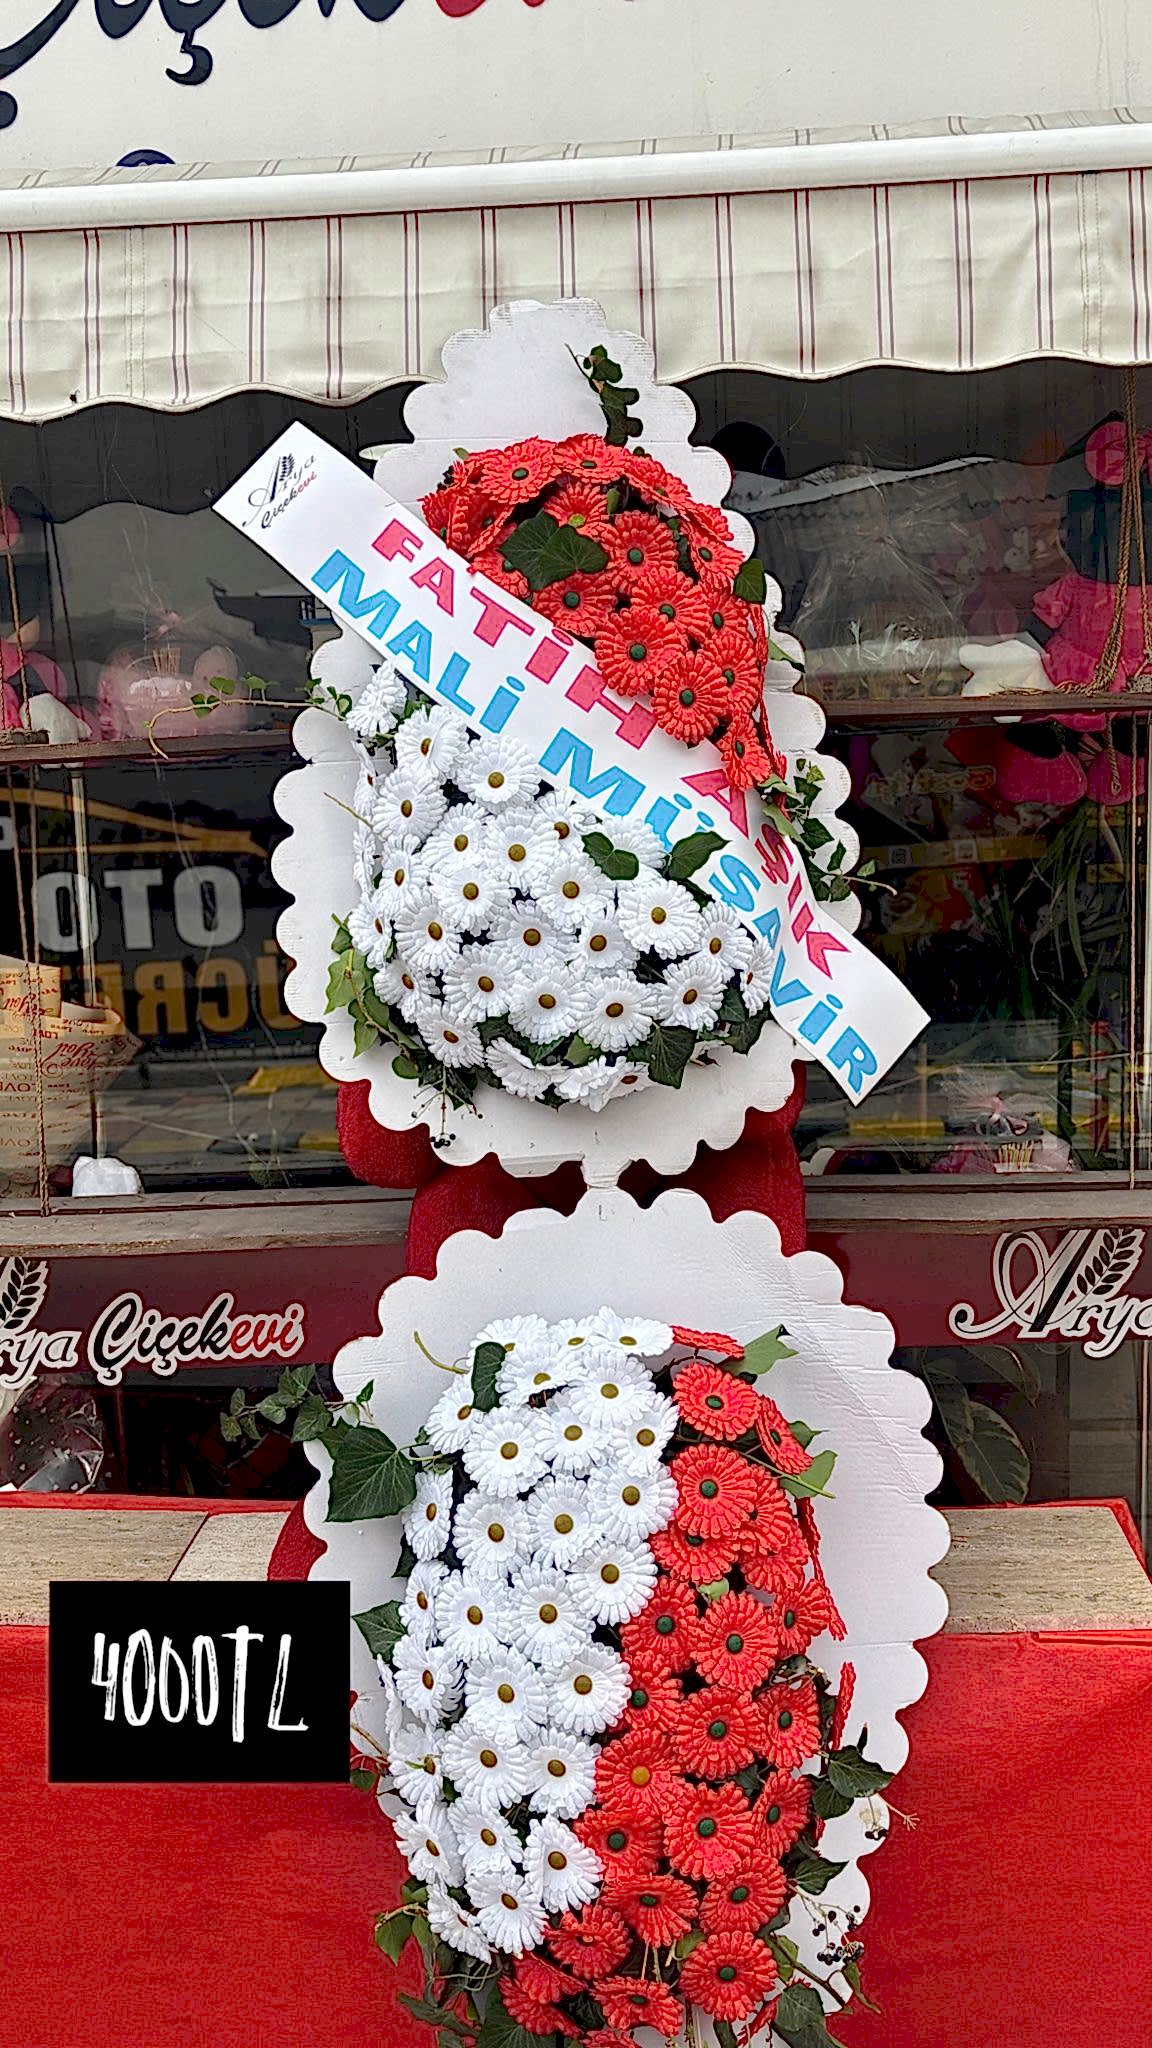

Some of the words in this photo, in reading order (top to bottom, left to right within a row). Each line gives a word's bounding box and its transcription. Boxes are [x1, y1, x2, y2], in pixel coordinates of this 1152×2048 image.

[310, 548, 527, 735] MALİ
[371, 518, 658, 751] FATİH
[680, 768, 853, 980] AŞIK
[88, 1292, 304, 1386] Çiçekevi
